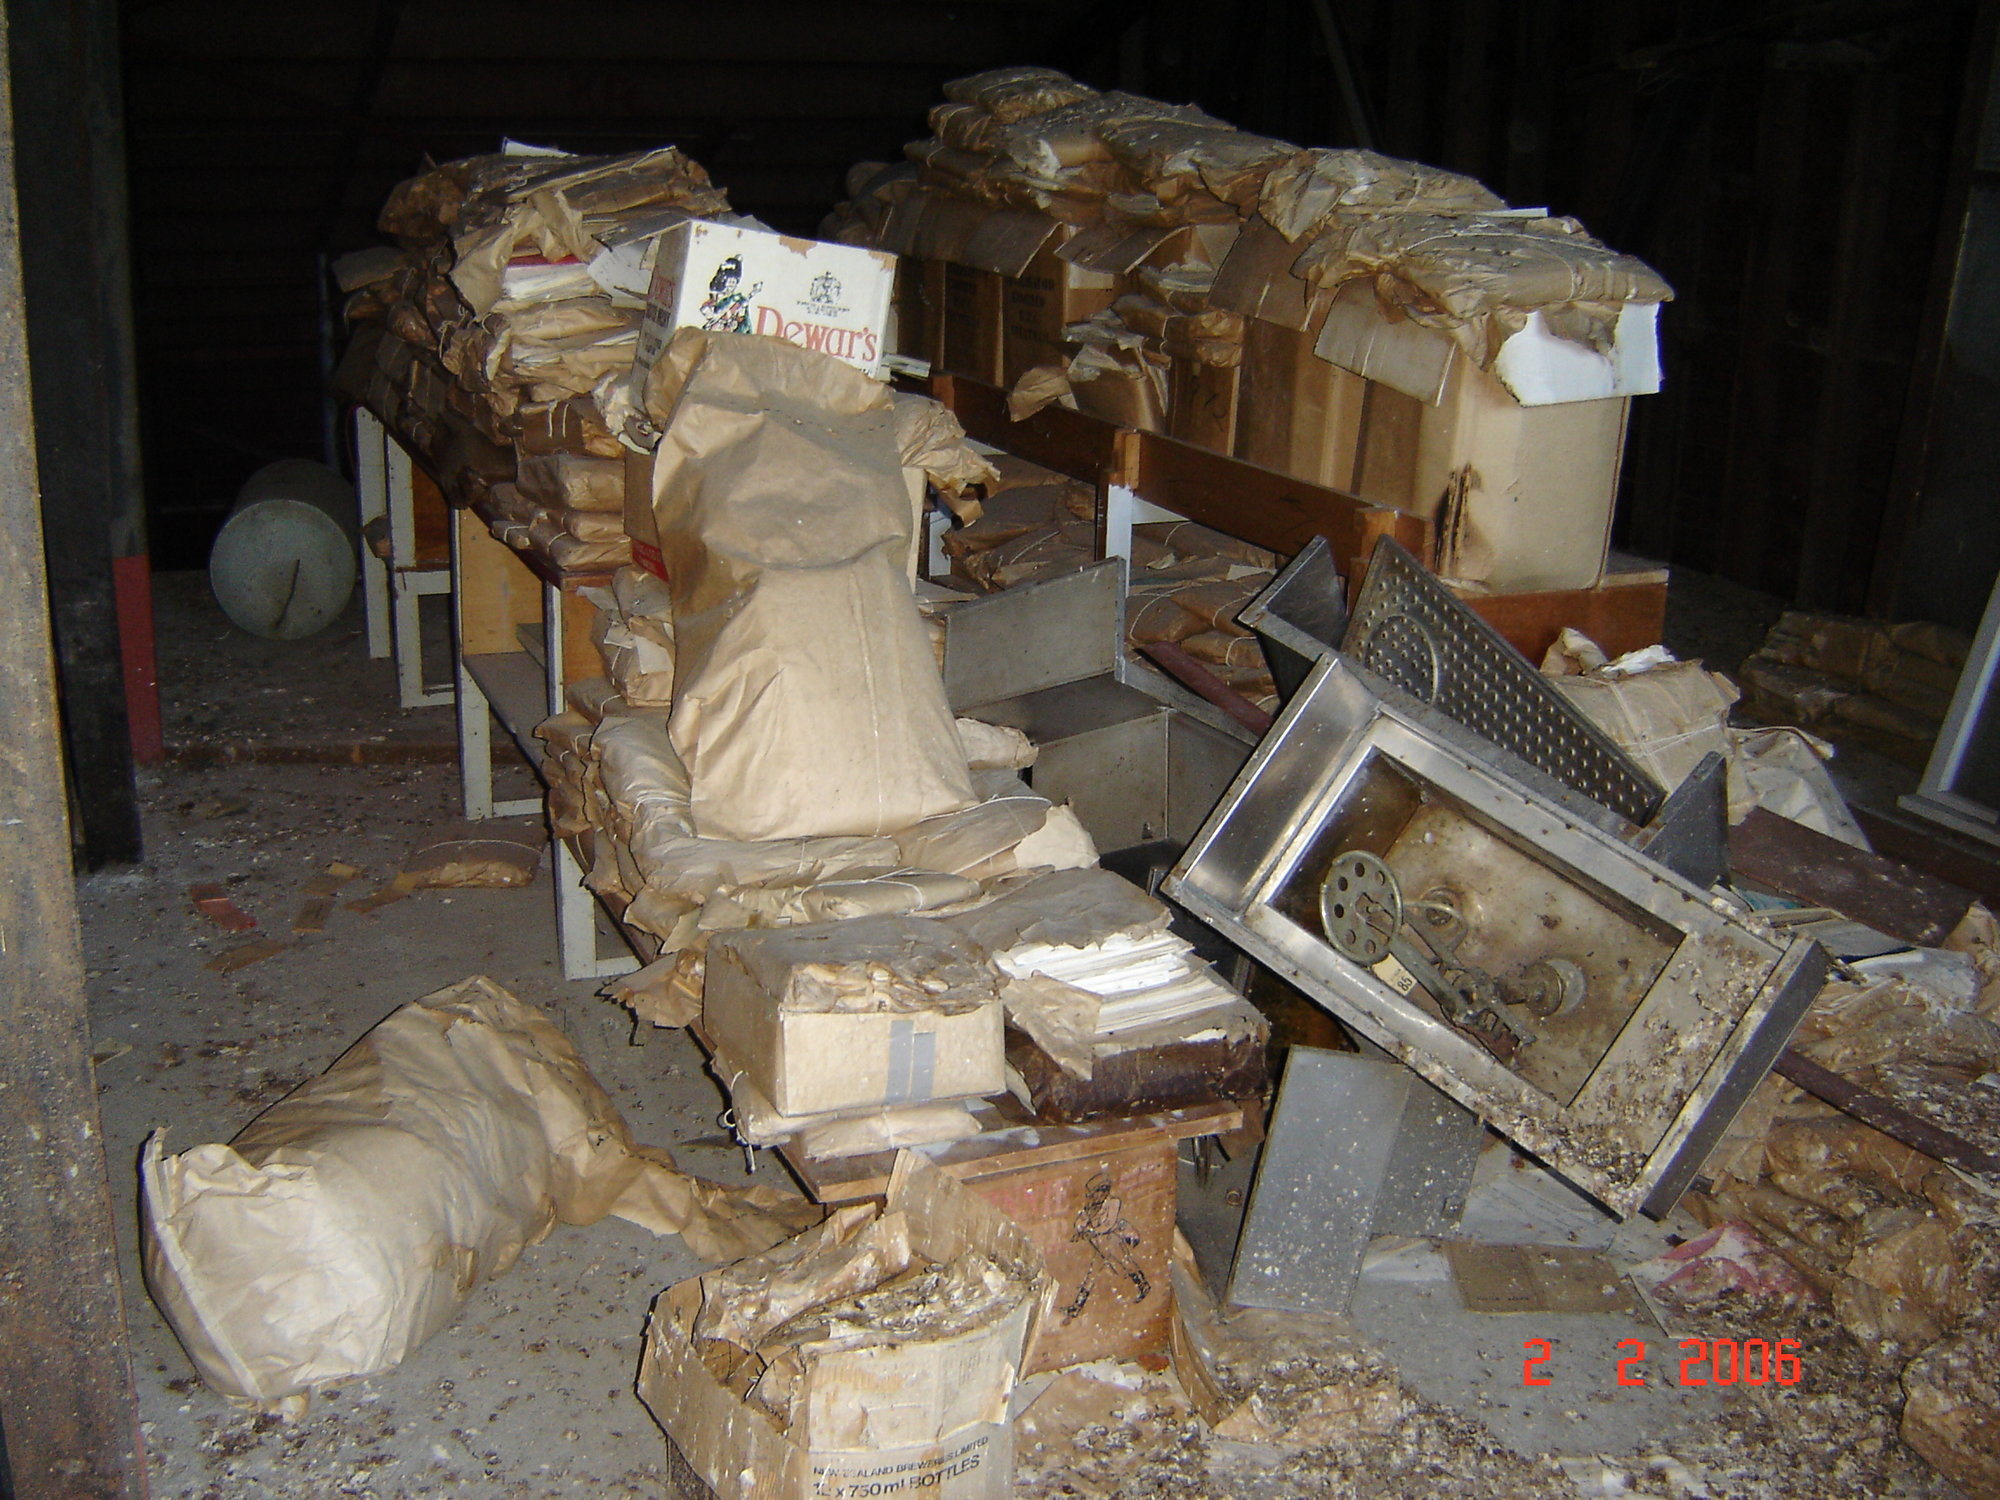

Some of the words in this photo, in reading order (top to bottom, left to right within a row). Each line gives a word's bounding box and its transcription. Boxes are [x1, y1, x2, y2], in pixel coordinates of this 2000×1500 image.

[756, 305, 878, 362] Dewar's
[1397, 976, 1413, 991] 85
[955, 1436, 989, 1457] LIMITED
[835, 1487, 845, 1498] x
[909, 1454, 980, 1489] BOTTLES
